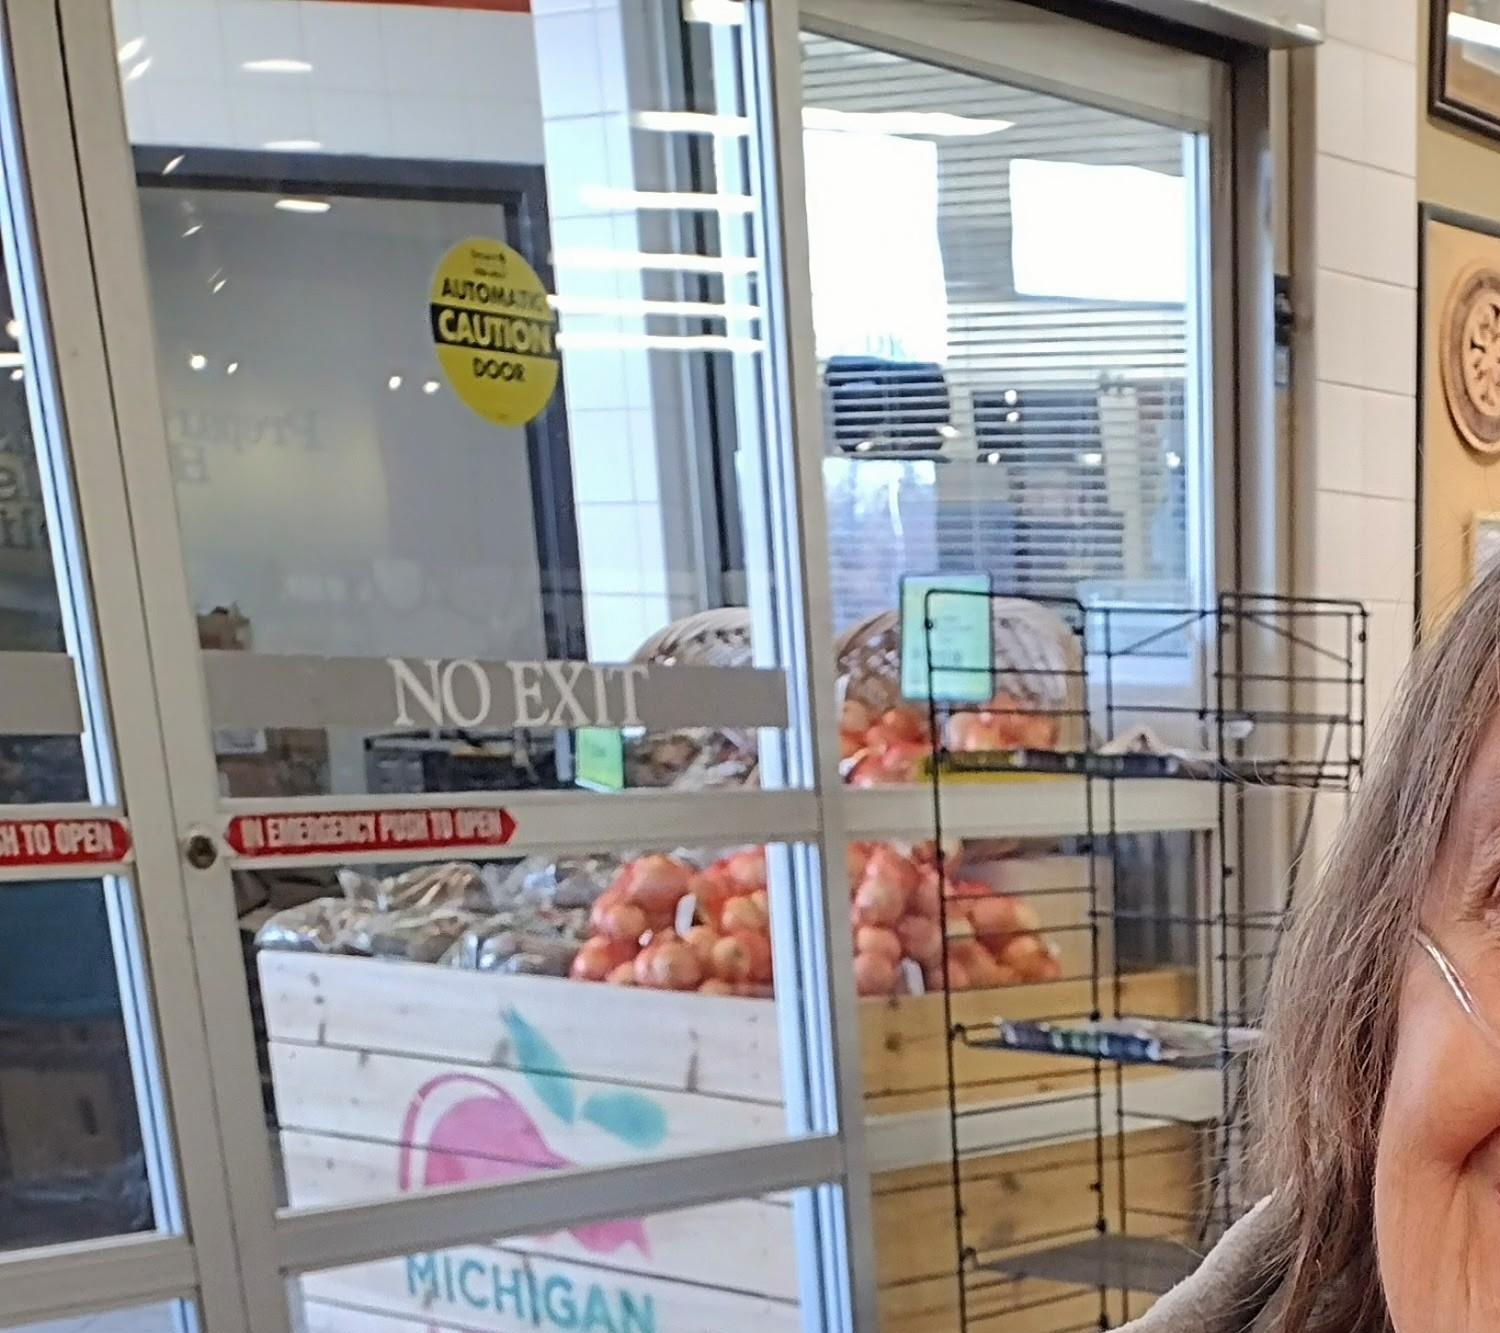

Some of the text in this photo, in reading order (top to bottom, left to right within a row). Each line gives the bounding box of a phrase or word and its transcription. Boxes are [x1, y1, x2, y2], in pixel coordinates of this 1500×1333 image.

[442, 278, 544, 311] AUTOMATIC
[438, 309, 550, 353] CAUTION
[472, 357, 526, 382] DOOR
[387, 657, 649, 727] NO EXIT
[20, 823, 51, 855] TO
[54, 822, 114, 854] OPEN
[240, 807, 502, 850] IN EMERGENCY PUSH TO OPEN
